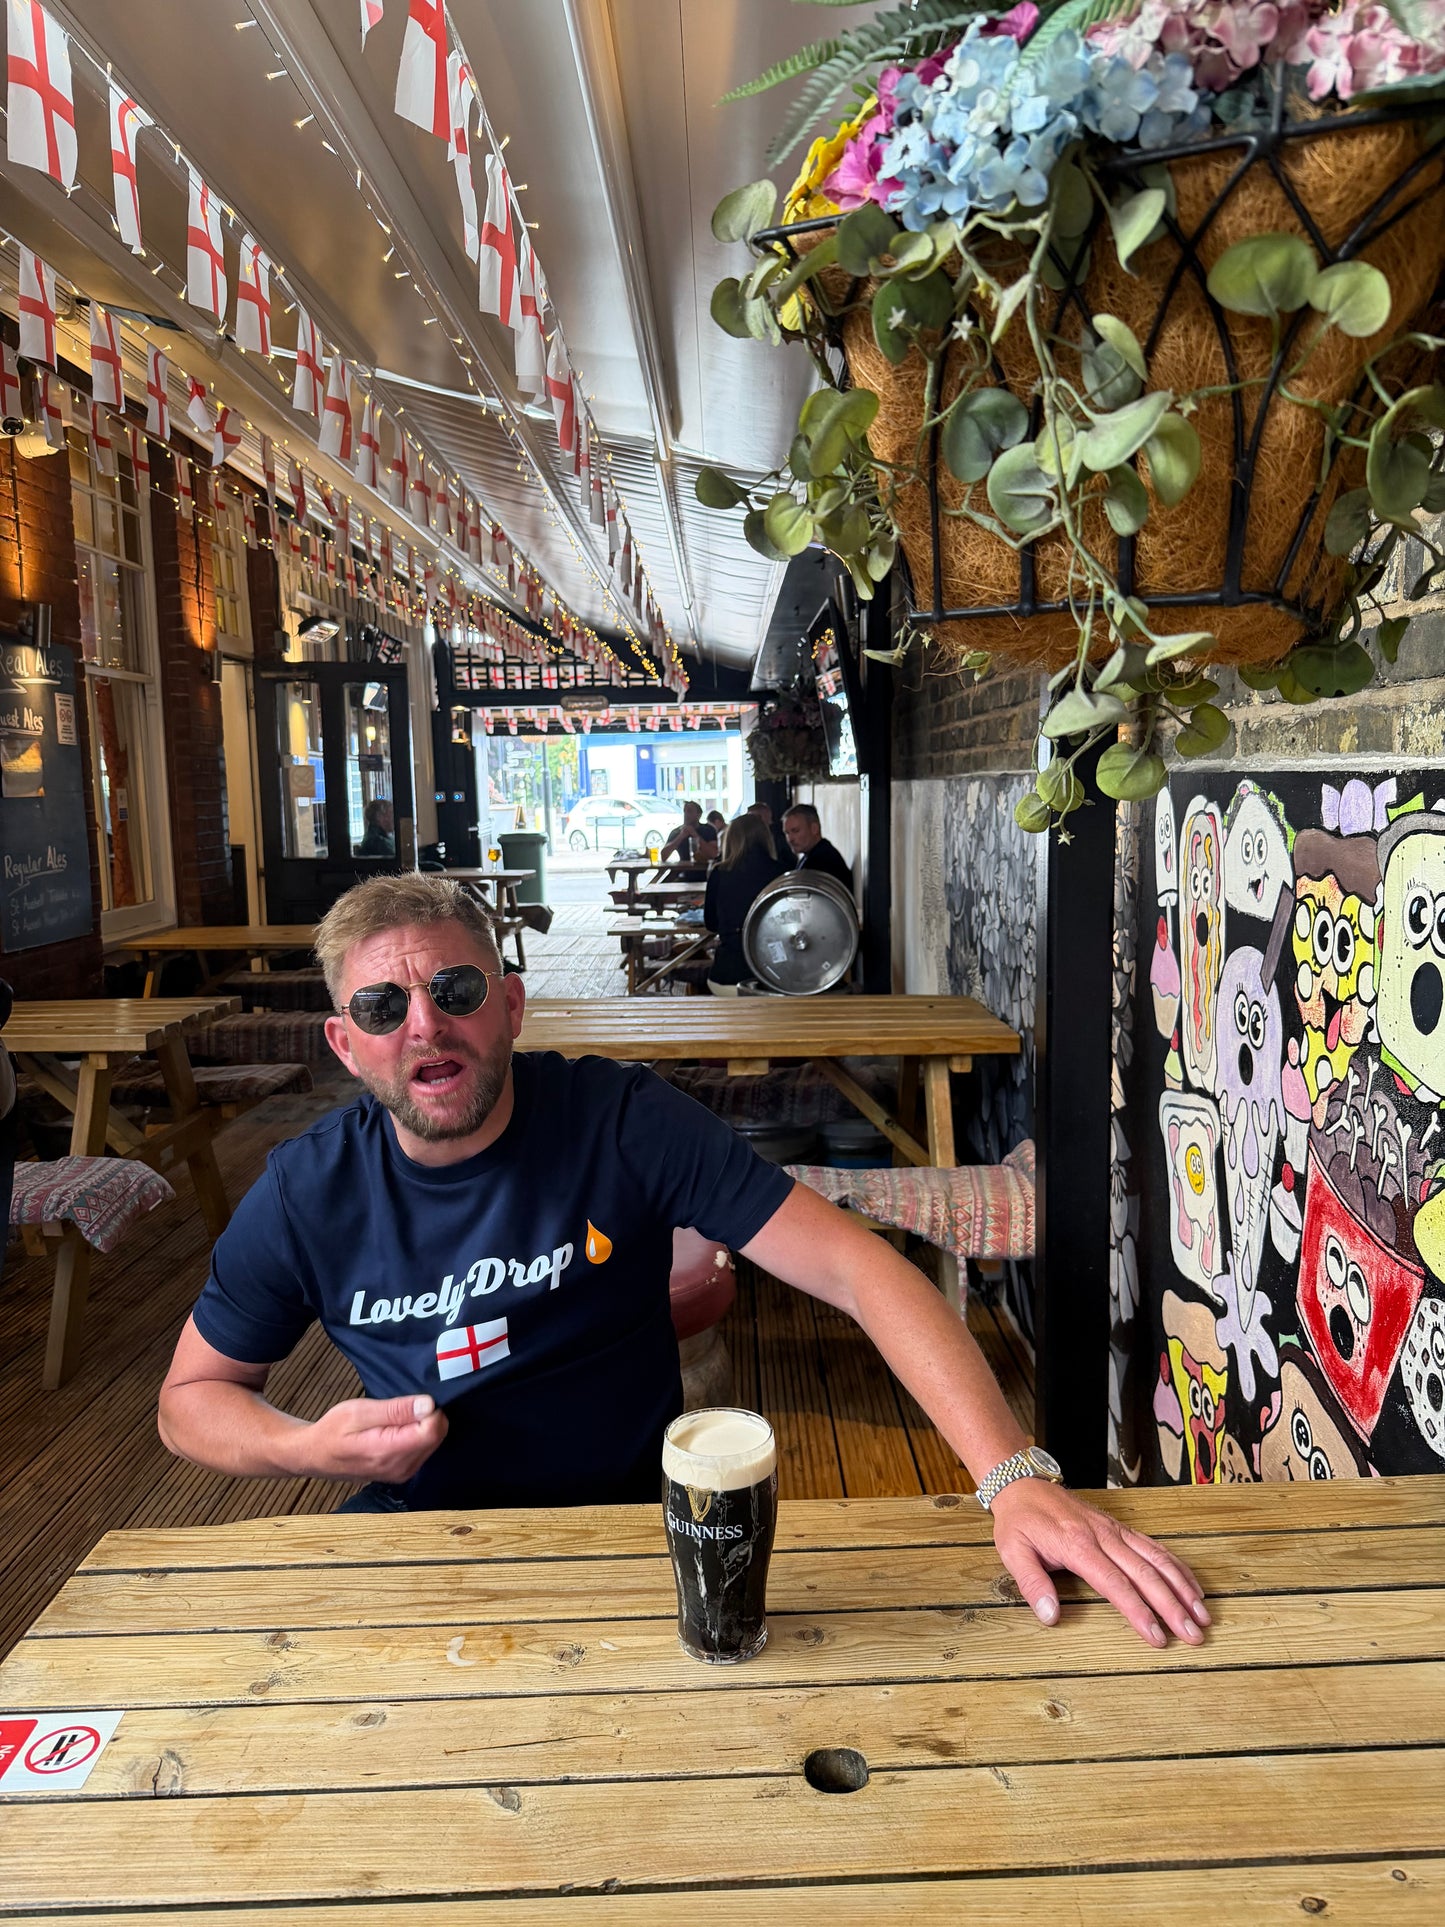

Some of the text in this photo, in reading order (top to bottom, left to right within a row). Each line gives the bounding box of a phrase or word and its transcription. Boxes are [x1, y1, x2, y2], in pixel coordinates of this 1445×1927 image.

[0, 706, 44, 731] uest Ales
[4, 845, 67, 887] Regular Ales
[666, 1511, 743, 1540] GUINNESS
